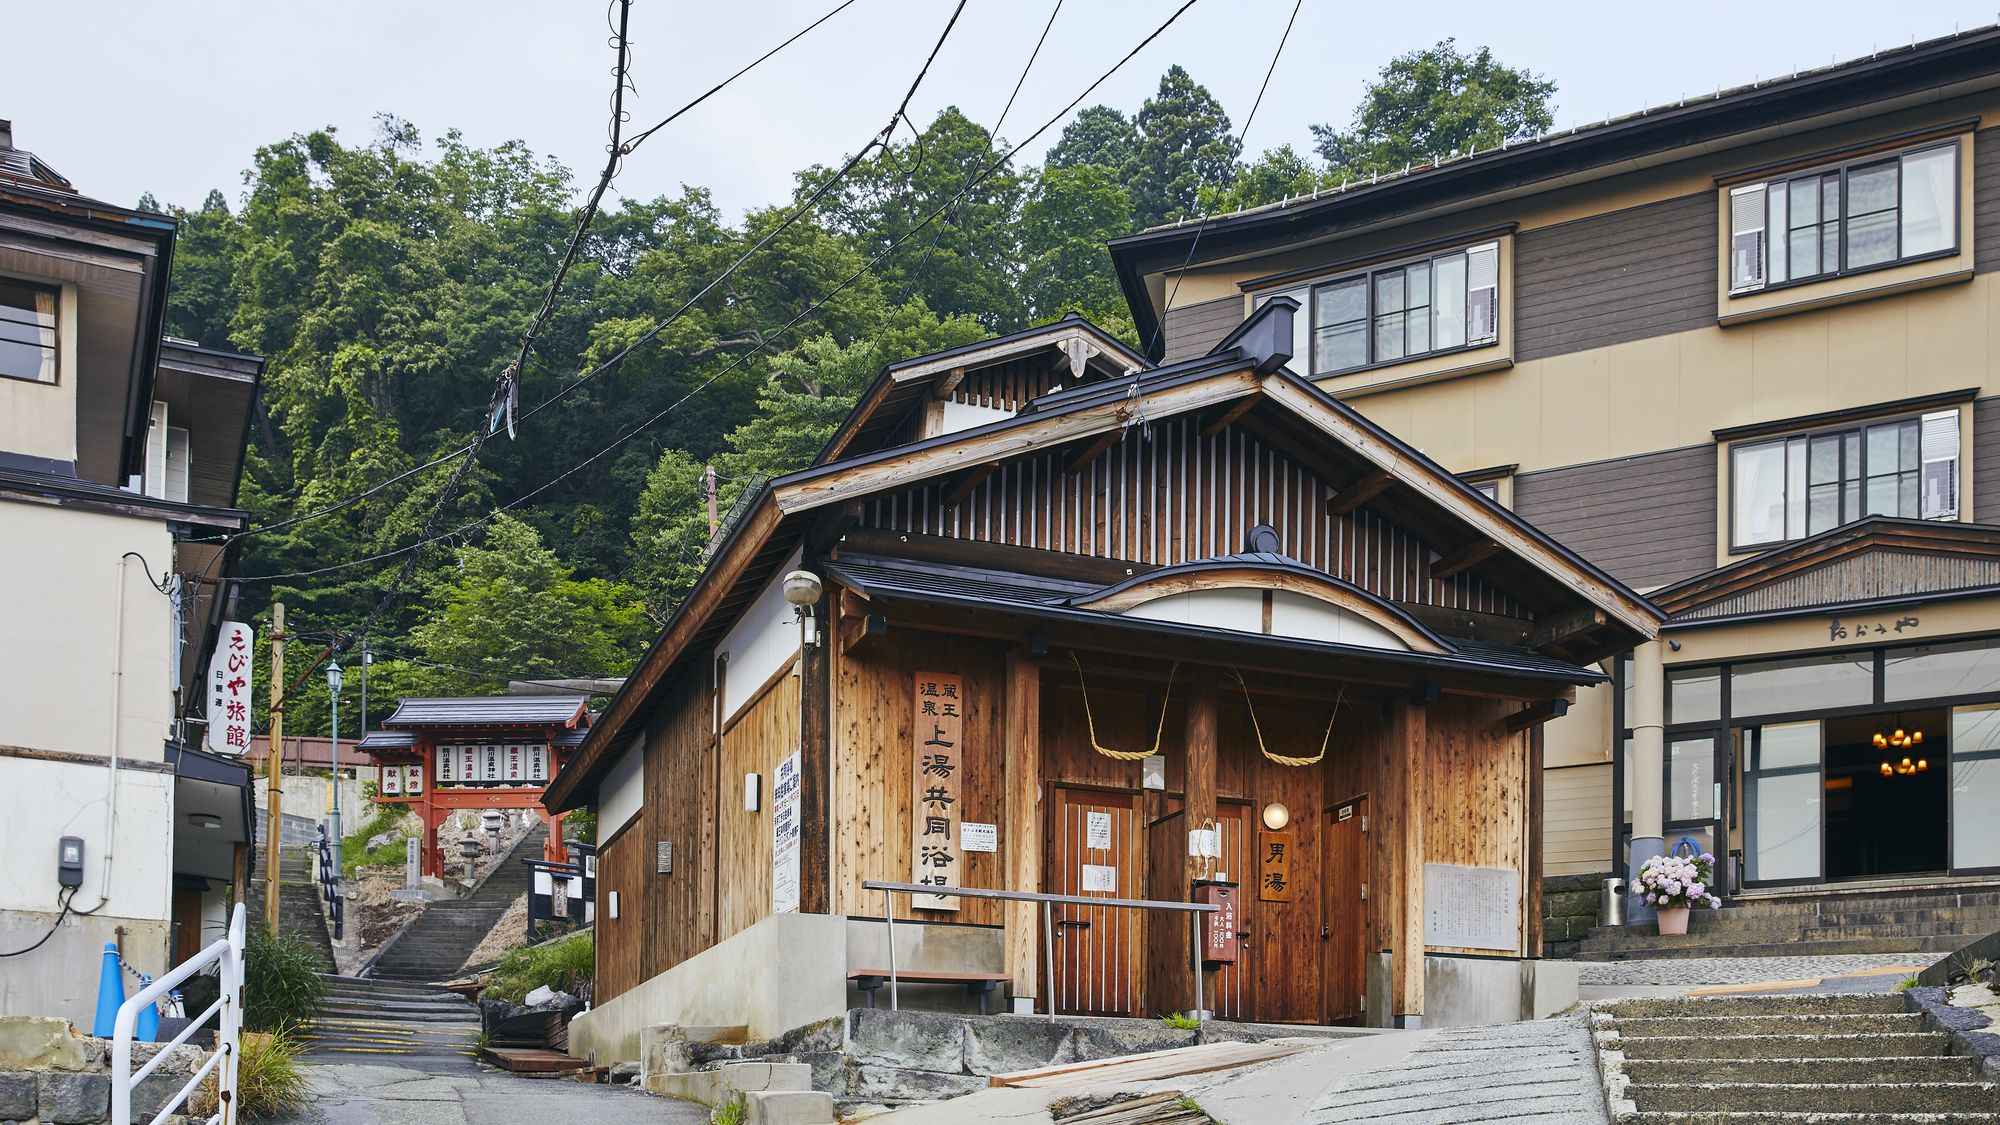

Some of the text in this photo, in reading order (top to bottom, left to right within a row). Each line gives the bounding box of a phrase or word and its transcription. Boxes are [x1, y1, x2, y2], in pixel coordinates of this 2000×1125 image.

[226, 629, 248, 748] えびや旅館
[920, 683, 940, 716] 温泉
[920, 724, 955, 900] 上湯共同浴場
[1265, 843, 1287, 892] 男湯
[1225, 902, 1233, 939] 入浴料金
